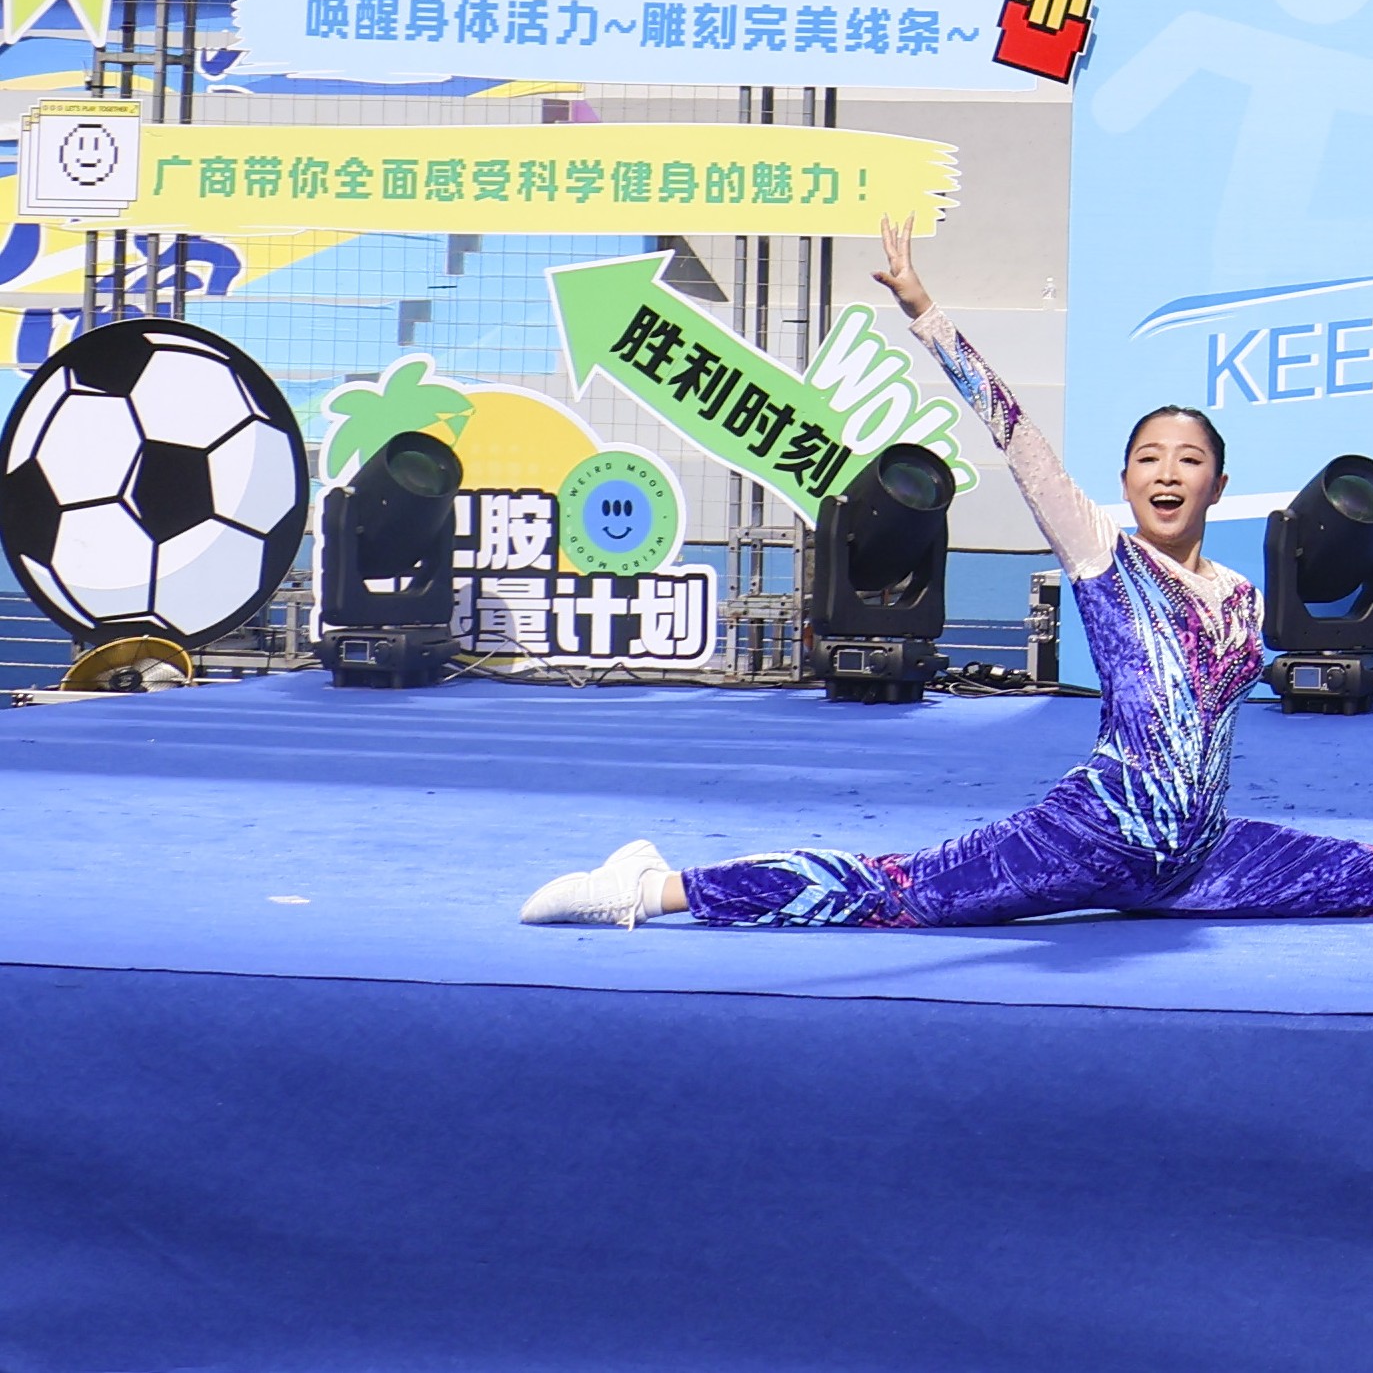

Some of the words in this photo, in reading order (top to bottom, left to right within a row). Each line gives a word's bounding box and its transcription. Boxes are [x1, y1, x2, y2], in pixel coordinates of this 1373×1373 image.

[609, 303, 853, 499] 胜利时刻
[569, 462, 612, 497] WEIRD
[626, 463, 664, 498] MOOD
